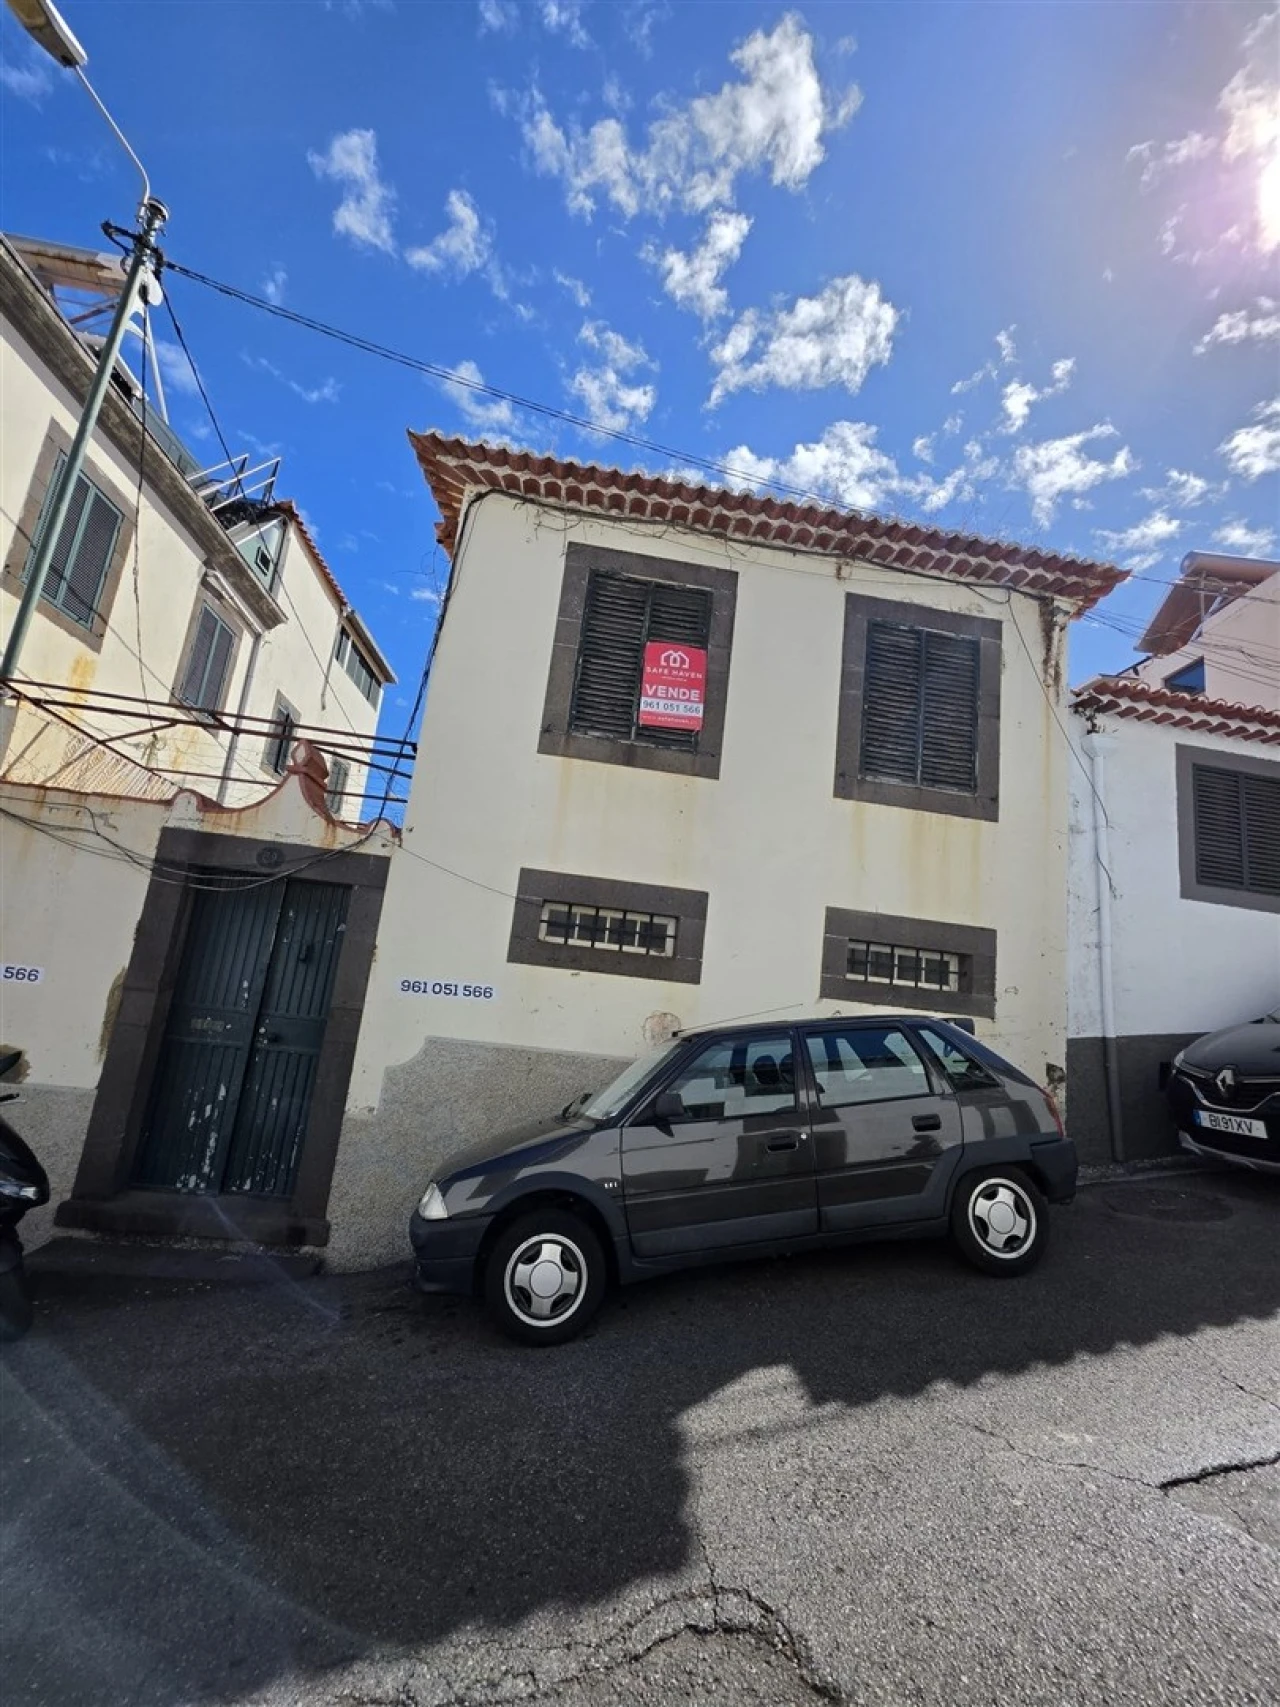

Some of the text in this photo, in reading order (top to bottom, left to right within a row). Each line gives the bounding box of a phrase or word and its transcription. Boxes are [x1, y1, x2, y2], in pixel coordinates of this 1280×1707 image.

[646, 666, 669, 674] SAFE
[671, 670, 702, 679] HAVEN
[645, 684, 700, 700] VENDE
[643, 700, 700, 714] 961 051 566
[3, 966, 40, 982] 566
[401, 980, 493, 999] 961 051 566
